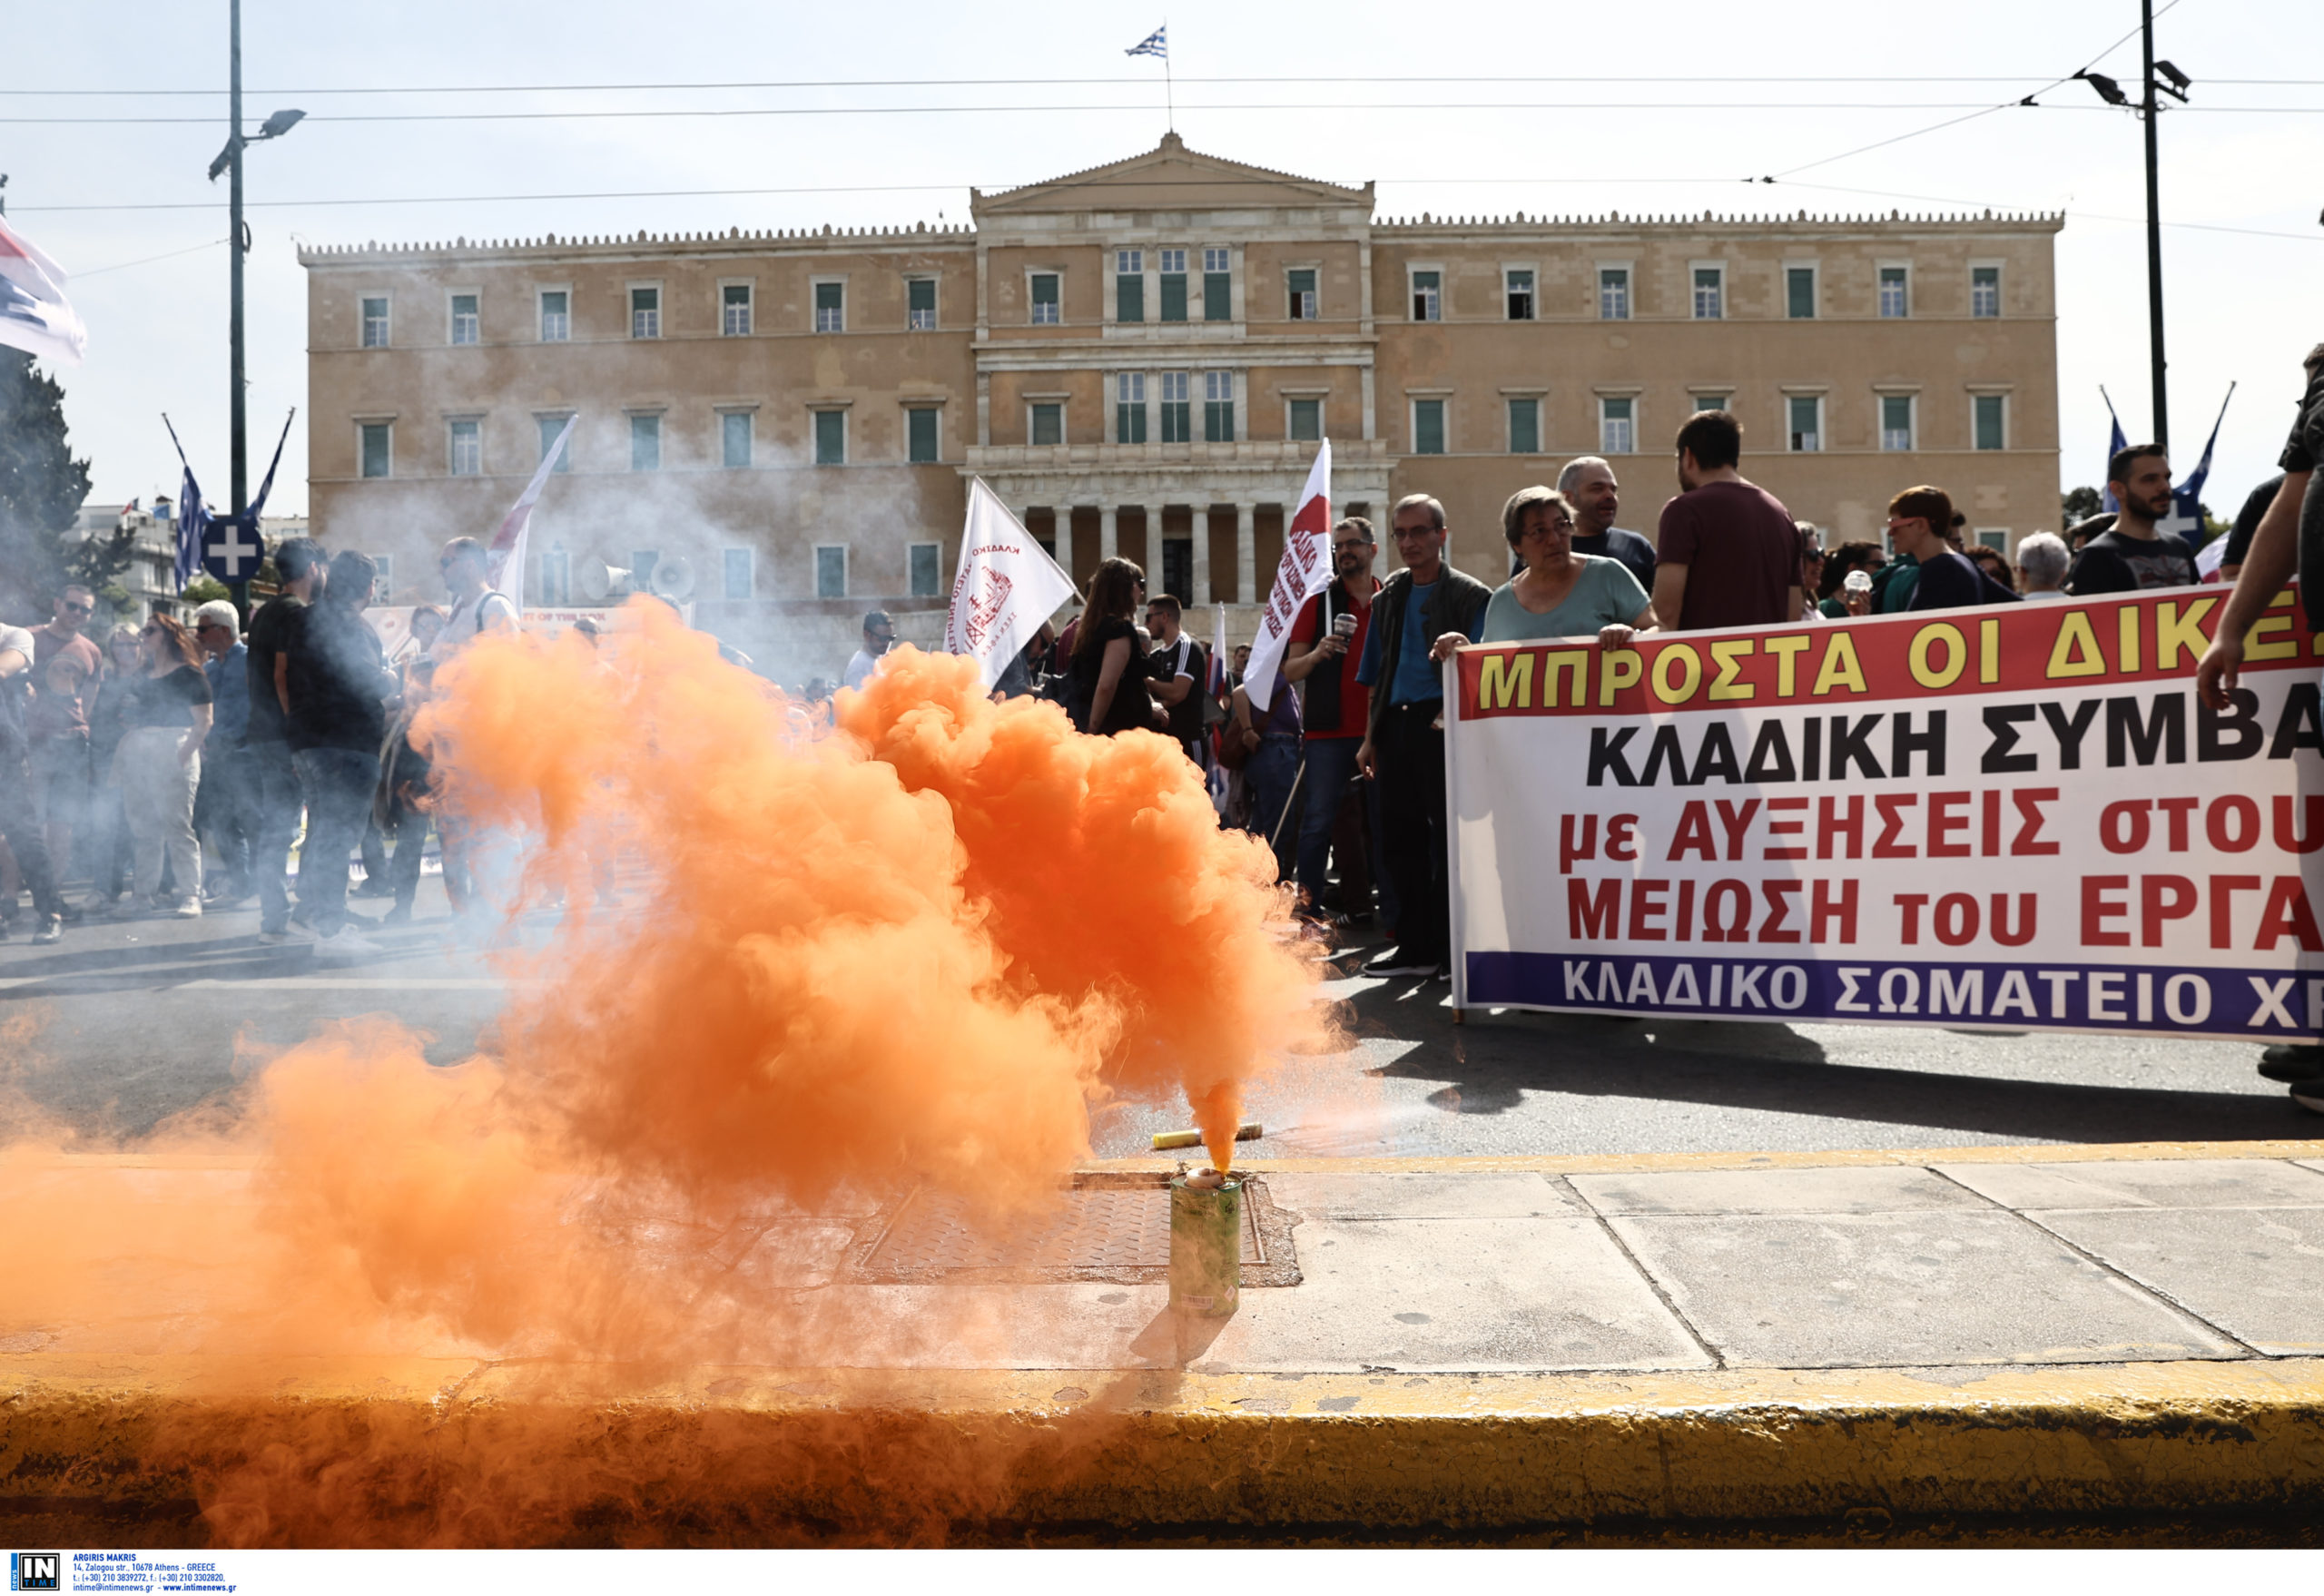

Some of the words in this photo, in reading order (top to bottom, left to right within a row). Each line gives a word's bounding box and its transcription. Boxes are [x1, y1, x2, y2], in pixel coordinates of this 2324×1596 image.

[537, 613, 553, 621] OF
[1479, 631, 1868, 711] ΜΠΡΟΣΤΑ
[1908, 618, 2000, 689] ΟΙ
[2045, 589, 2324, 680] ΔΙΚΕ
[1586, 709, 1946, 786] ΚΛΑΔΙΚΗ
[1559, 813, 1640, 874] με
[1666, 787, 2061, 862] ΑΥΞΗΣΕΙΣ
[1566, 878, 1860, 944] ΜΕΙΩΣΗ
[1893, 892, 2038, 947] του
[2081, 874, 2324, 952] ΕΡΓΑ
[1562, 961, 1808, 1010] ΚΛΑΔΙΚΟ
[1835, 967, 2212, 1024] ΣΩΜΑΤΕΙΟ
